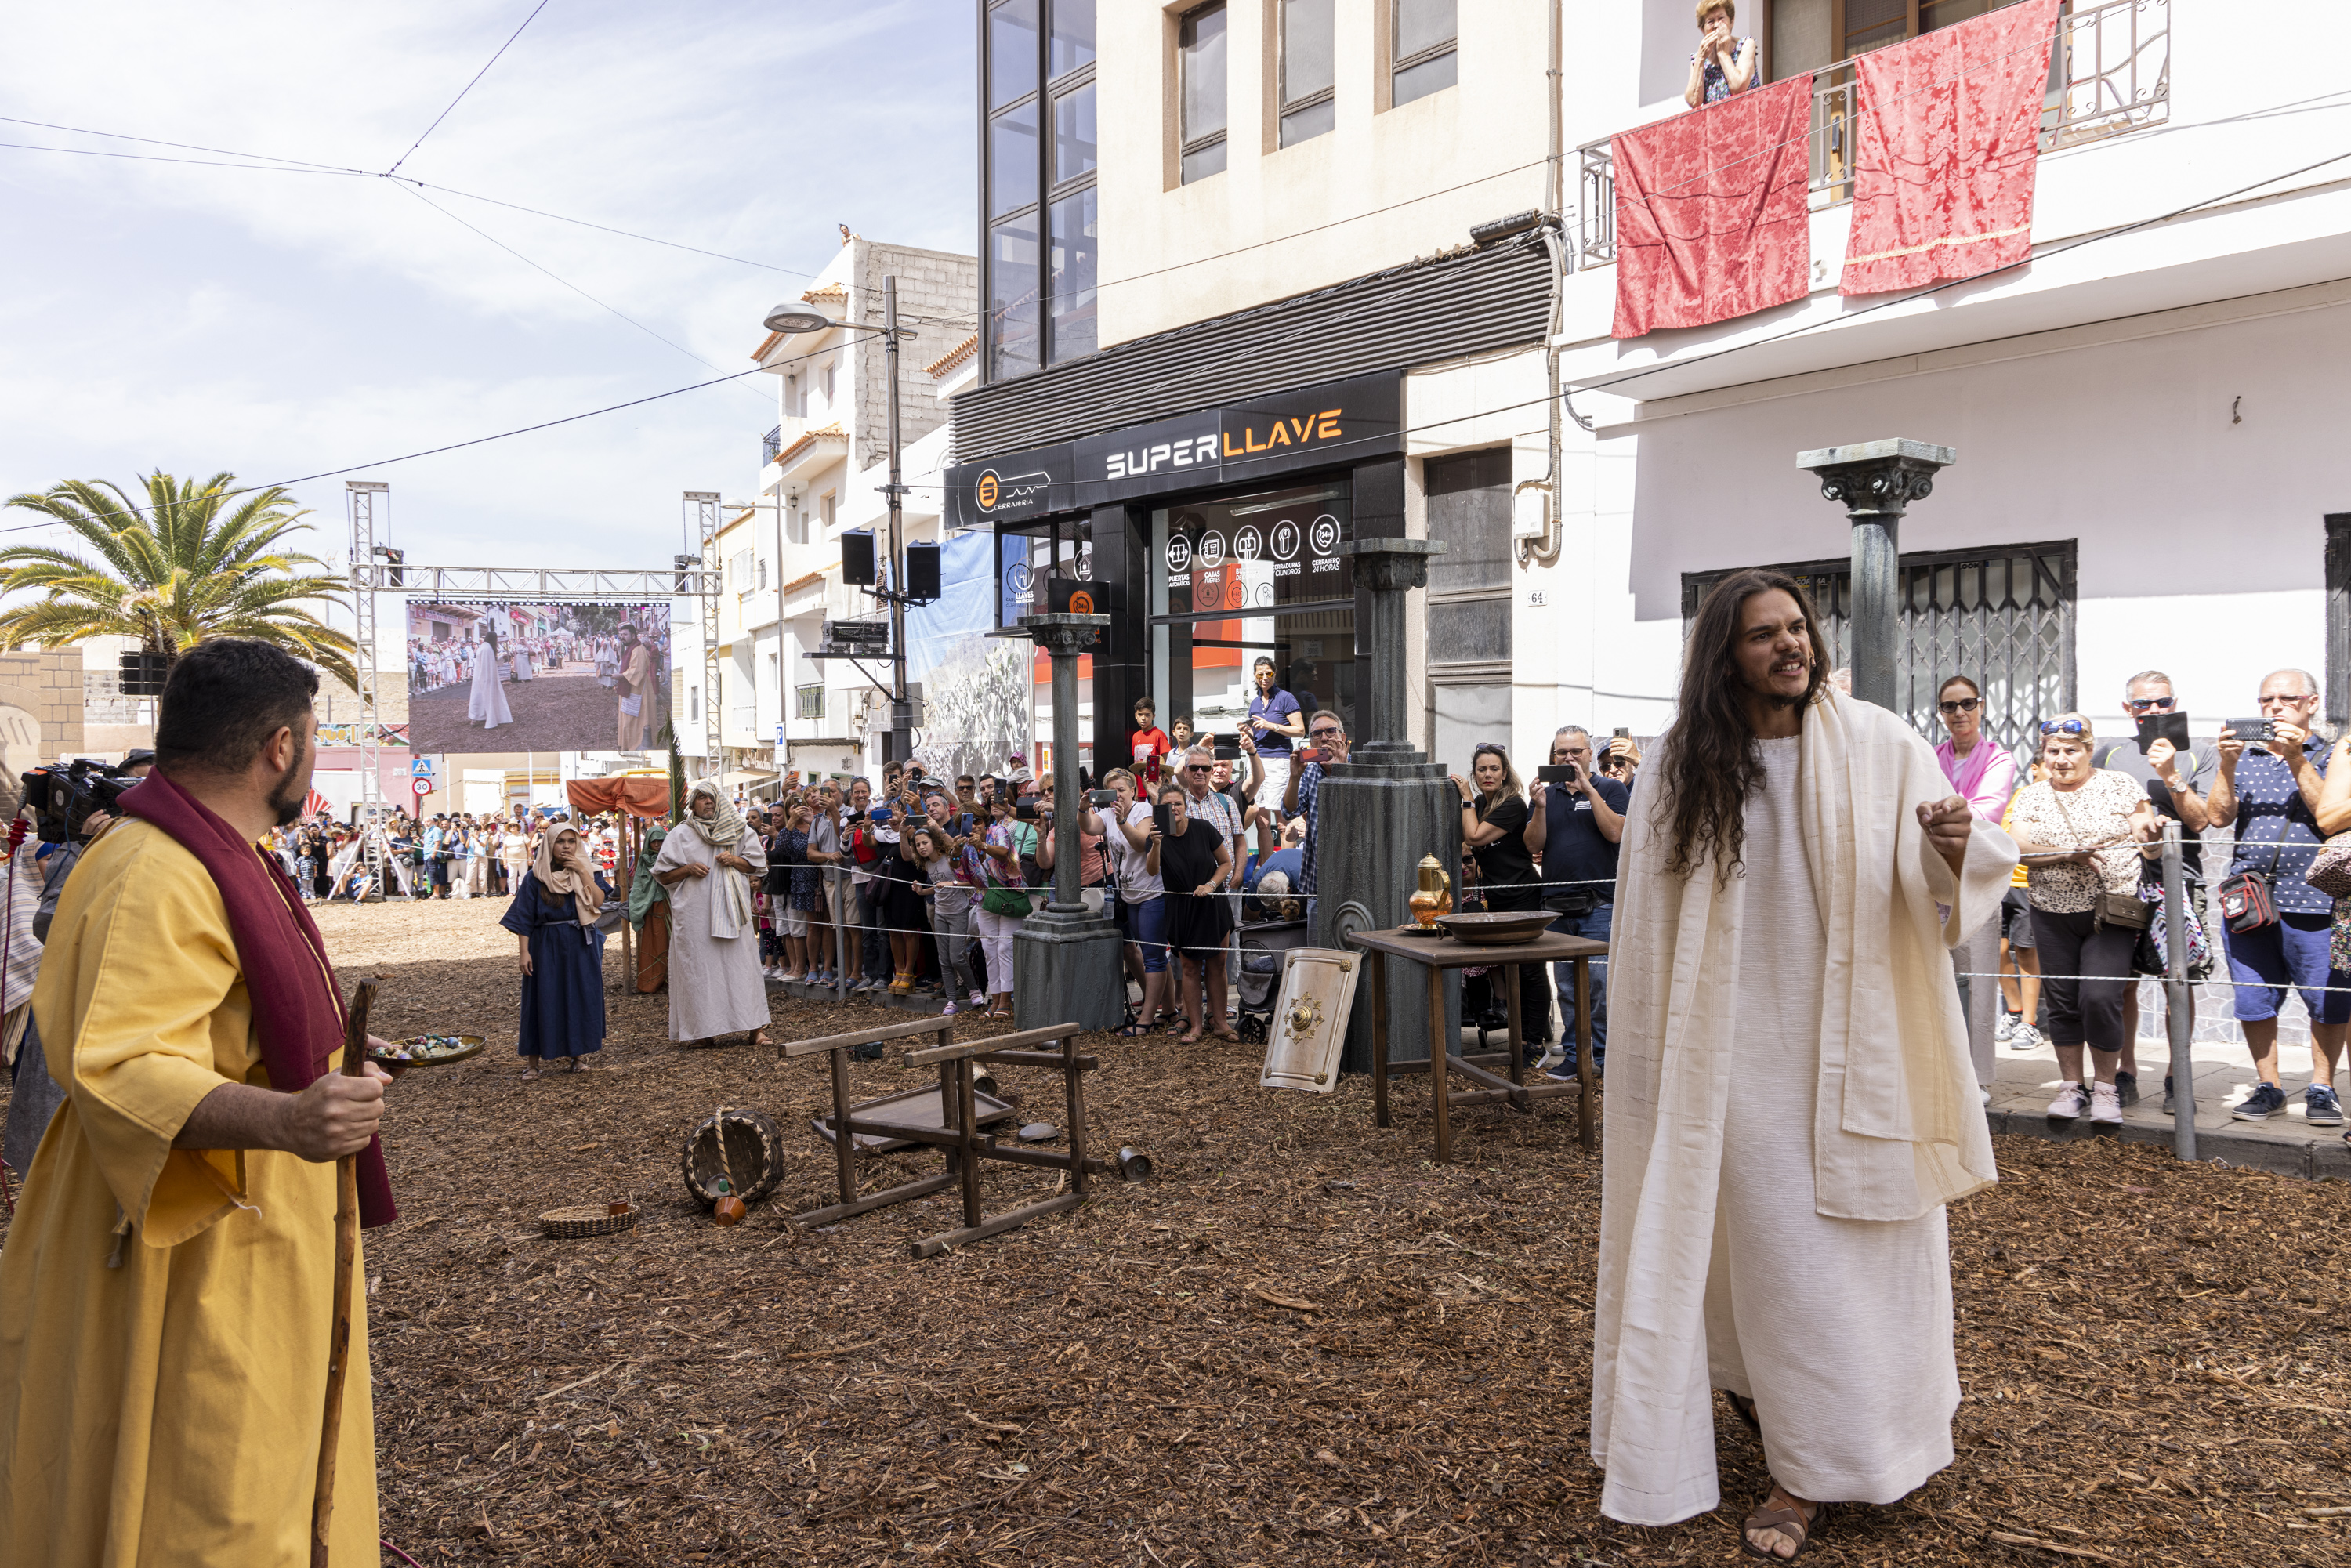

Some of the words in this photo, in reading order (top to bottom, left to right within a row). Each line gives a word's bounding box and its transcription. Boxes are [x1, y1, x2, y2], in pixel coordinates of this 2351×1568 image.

[994, 497, 1033, 511] CERRAJERÍA
[1311, 557, 1340, 566] CERRAJERO
[1275, 567, 1301, 577] CILINDROS
[1320, 563, 1340, 572] HORAS
[1168, 574, 1190, 582] PUERTAS
[1016, 590, 1034, 600] LLAVES
[1531, 592, 1543, 603] 64
[777, 727, 783, 744] P
